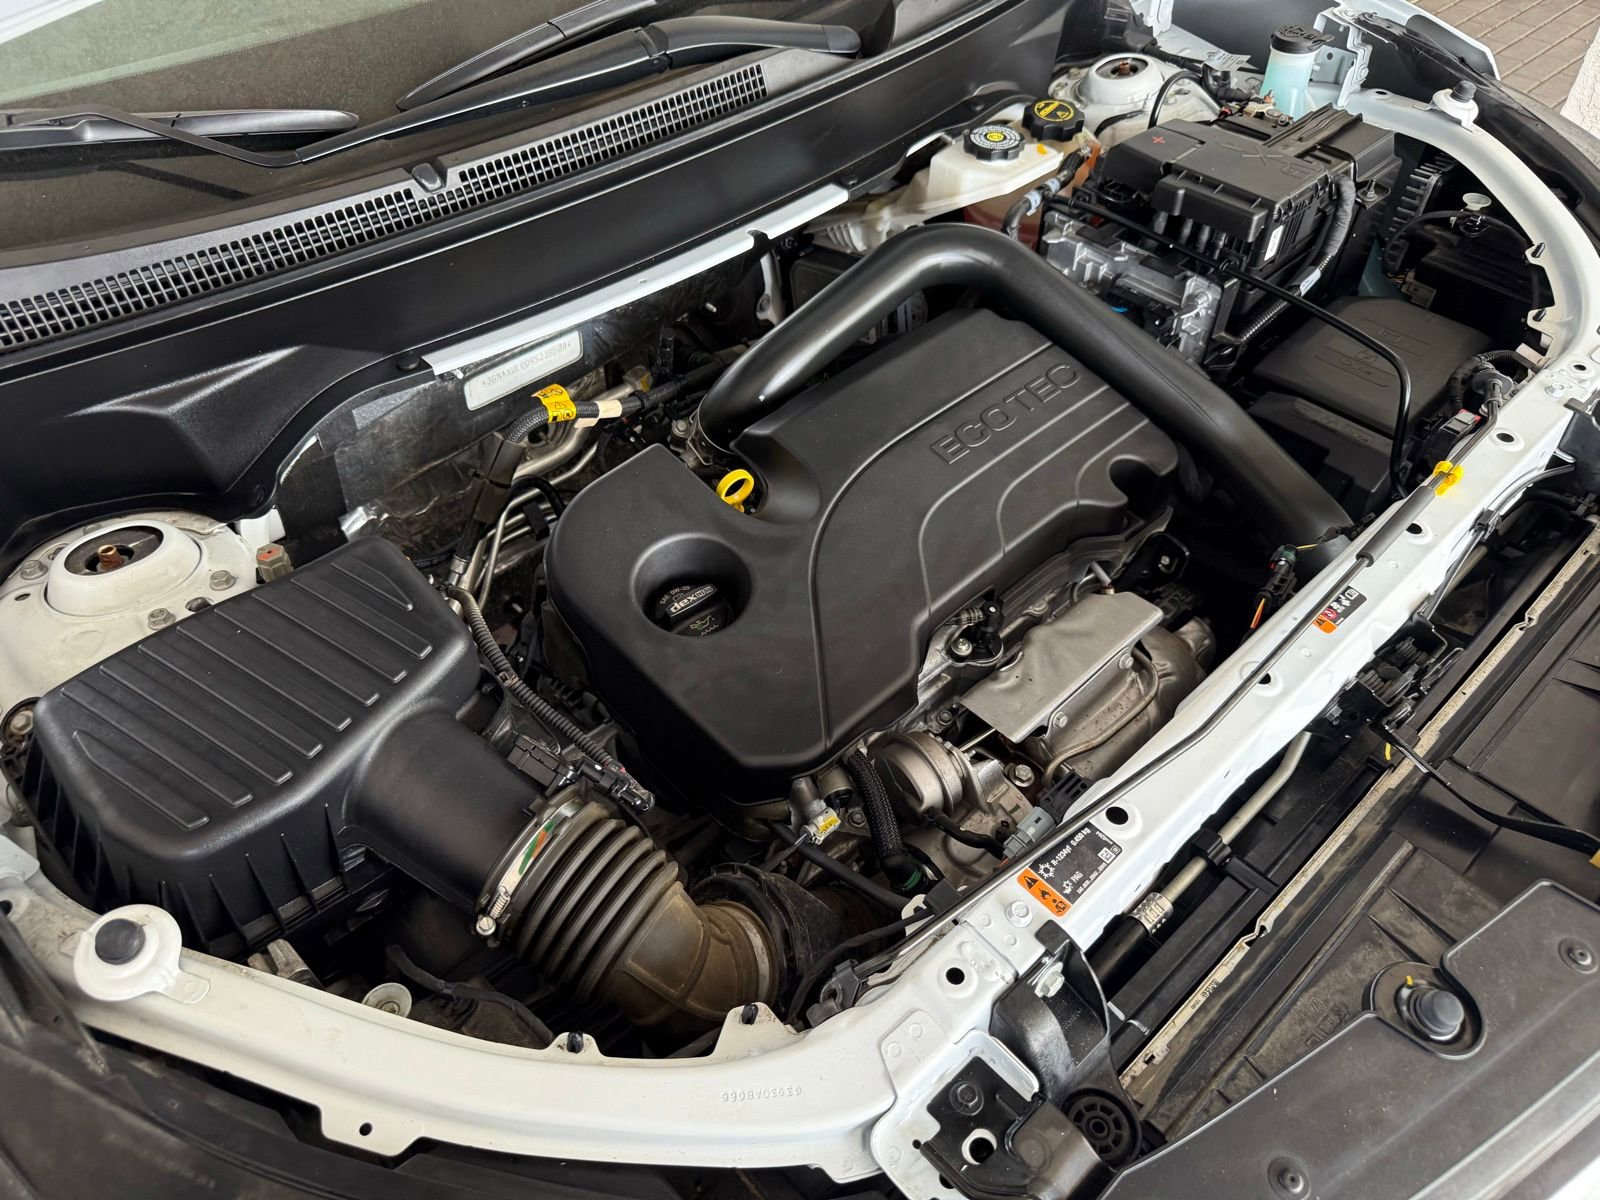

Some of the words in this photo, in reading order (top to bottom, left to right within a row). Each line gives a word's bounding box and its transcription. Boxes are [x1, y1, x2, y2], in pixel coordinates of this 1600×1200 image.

[929, 363, 1080, 464] ECOTEC
[670, 585, 714, 613] dexos
[1050, 844, 1072, 866] R-1234yf
[1070, 871, 1083, 883] PAG
